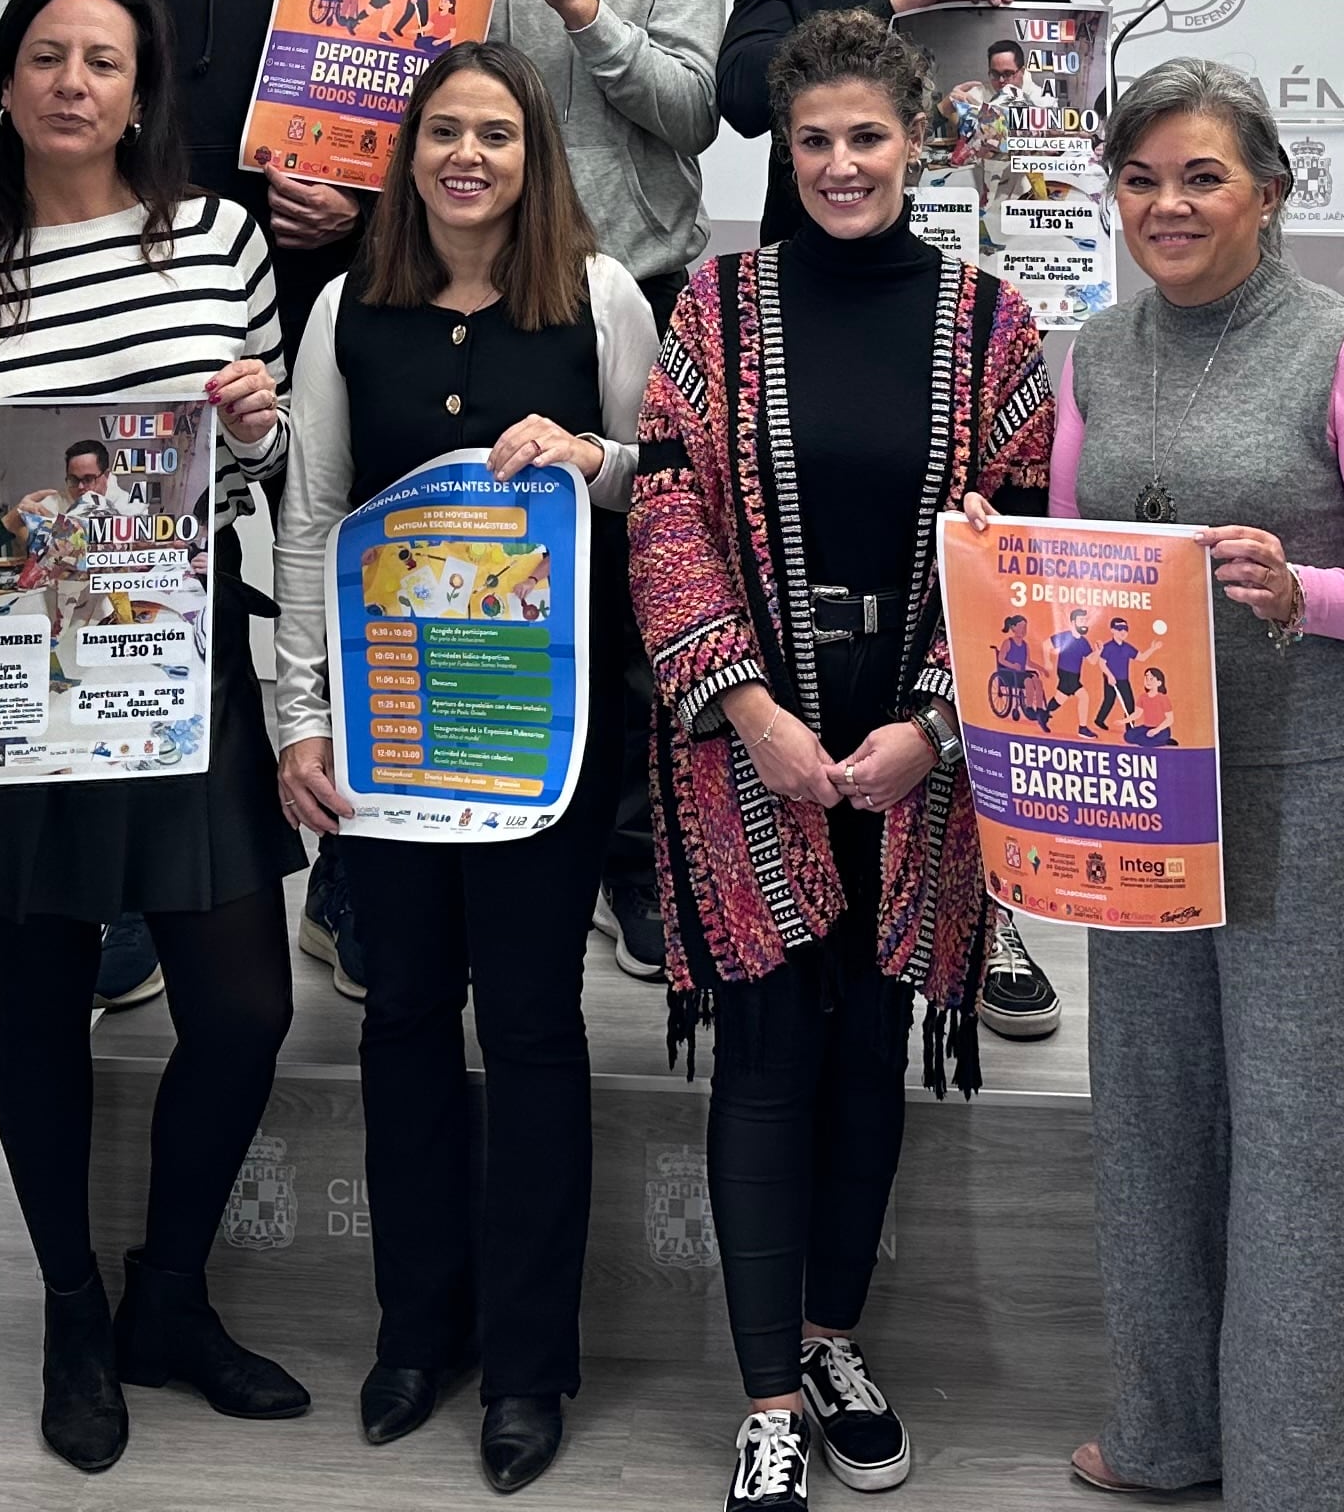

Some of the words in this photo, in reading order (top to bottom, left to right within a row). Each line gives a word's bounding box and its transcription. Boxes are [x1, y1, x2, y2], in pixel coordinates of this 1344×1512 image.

[1014, 19, 1093, 42] VUELA
[315, 41, 400, 72] DEPORTE
[1027, 50, 1080, 73] ALTO
[310, 60, 414, 97] BARRERA
[1042, 79, 1069, 97] AL
[308, 84, 356, 105] TODOS
[1009, 107, 1099, 133] MUNDO
[1008, 139, 1065, 150] COLLAGE
[1068, 140, 1089, 149] ART
[1012, 157, 1086, 174] Exposición
[912, 204, 972, 213] OVIEMBRE
[1006, 205, 1092, 220] Inauguración
[1030, 218, 1061, 230] 11.30
[1065, 219, 1074, 229] h
[1004, 254, 1045, 265] Apertura
[1067, 257, 1093, 267] cargo
[1004, 263, 1015, 271] de
[1025, 263, 1034, 271] la
[1044, 264, 1071, 272] danza
[1082, 264, 1093, 272] de
[1020, 272, 1045, 280] Paula
[1048, 272, 1080, 281] Oviedo
[99, 413, 194, 439] VUELA
[112, 448, 178, 474] ALTO
[129, 482, 161, 504] AL
[364, 487, 419, 511] JORNADA
[493, 481, 510, 493] DE
[89, 515, 199, 544] MUNDO
[87, 552, 155, 566] COLLAGE
[159, 551, 185, 563] ART
[998, 534, 1024, 553] DÍA
[1028, 538, 1141, 562] INTERNACIONAL
[1144, 546, 1163, 564] DE
[998, 555, 1020, 575] LA
[1026, 556, 1159, 586] DISCAPACIDAD
[92, 575, 179, 593] Exposición
[1010, 581, 1027, 608] 3
[1032, 583, 1053, 603] DE
[1058, 585, 1152, 611] DICIEMBRE
[82, 630, 186, 646] Inauguración
[110, 645, 149, 658] 11.30
[152, 645, 163, 656] h
[16, 671, 28, 680] de
[79, 689, 129, 702] Apertura
[154, 688, 185, 699] cargo
[79, 699, 91, 709] de
[104, 699, 115, 708] la
[127, 697, 159, 707] danza
[171, 695, 185, 705] de
[97, 708, 128, 719] Paula
[131, 706, 169, 718] Oviedo
[1009, 741, 1111, 776] DEPORTE
[1117, 753, 1158, 780] SIN
[1011, 766, 1158, 809] BARRERAS
[1012, 798, 1069, 823] TODOS
[1074, 807, 1163, 832] JUGAMOS
[328, 1211, 369, 1237] DE
